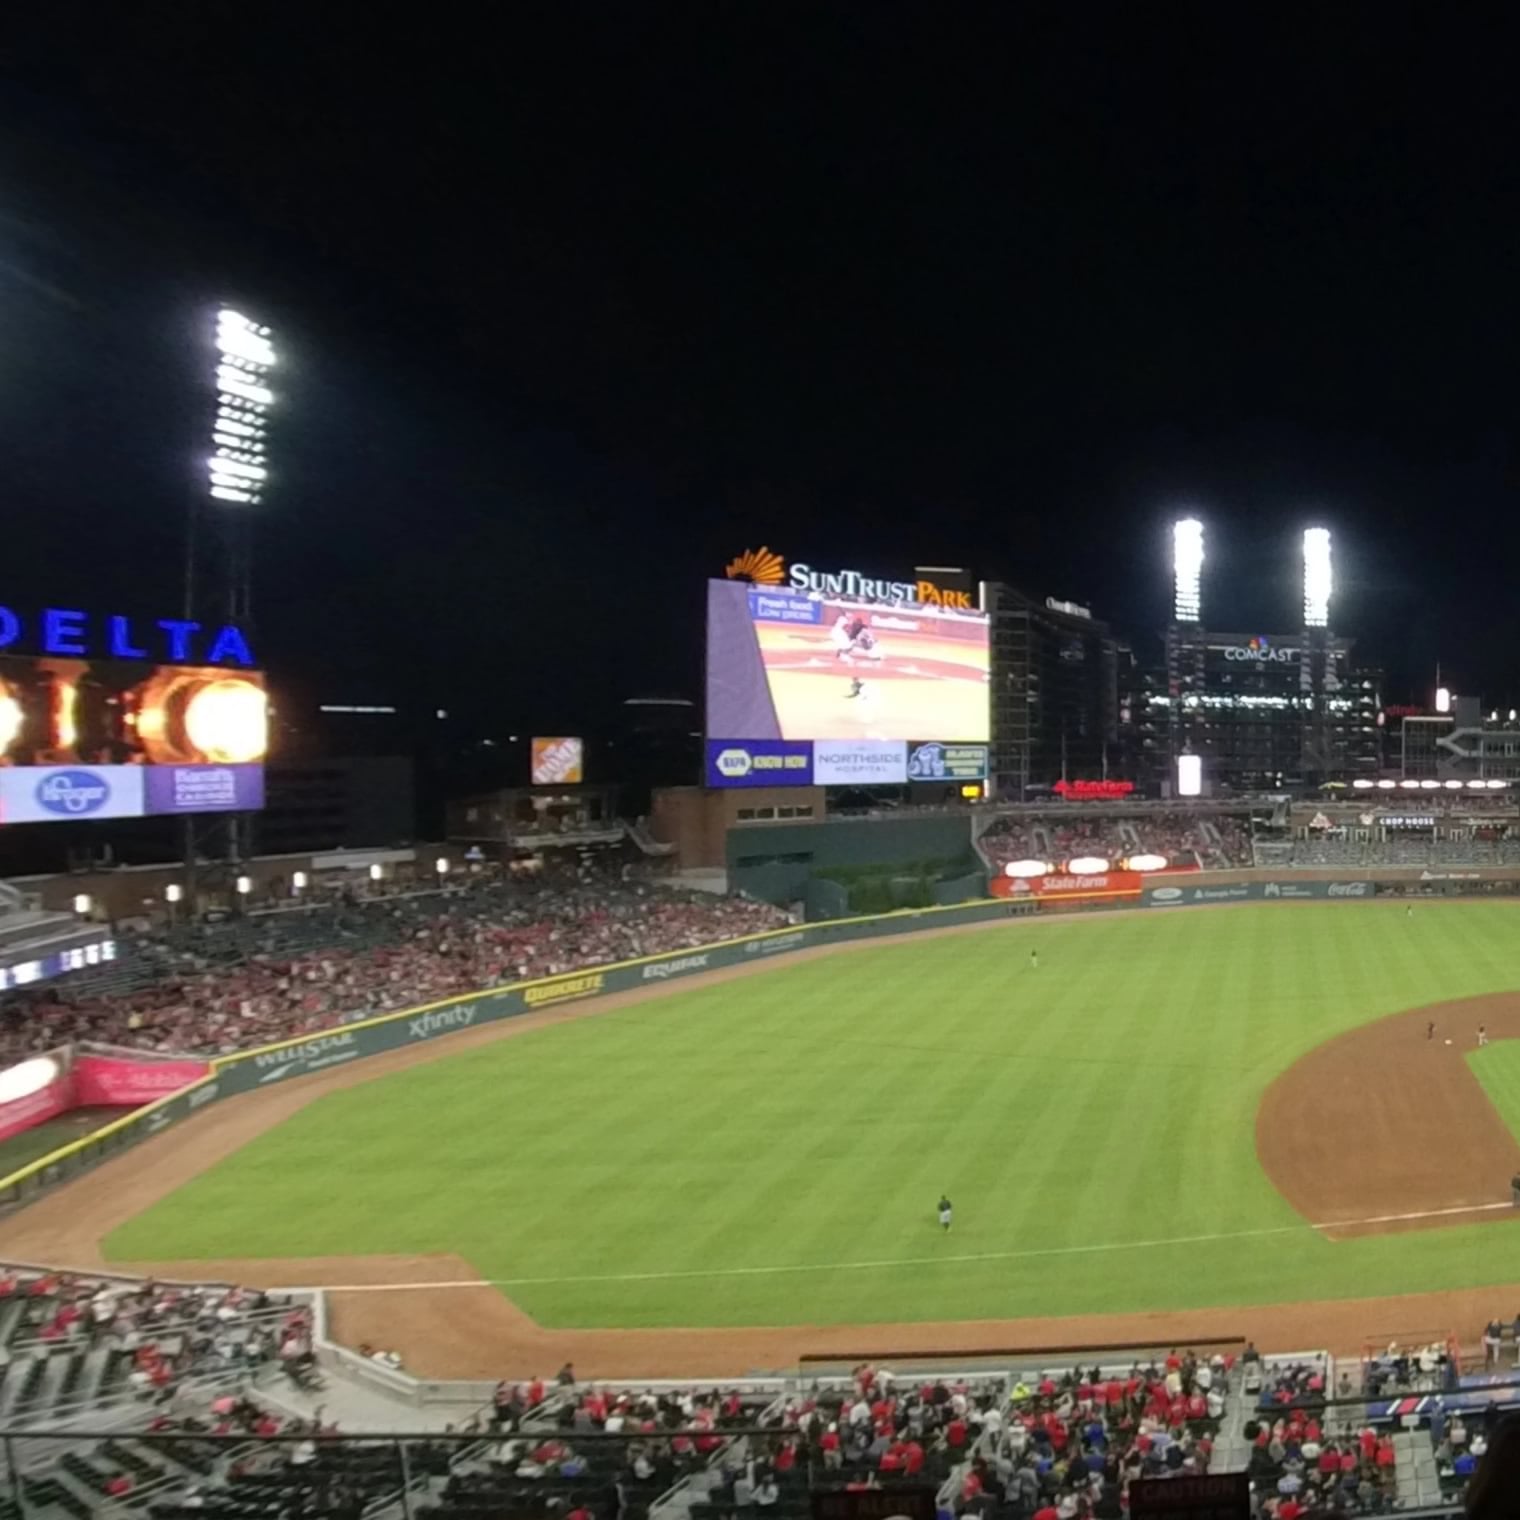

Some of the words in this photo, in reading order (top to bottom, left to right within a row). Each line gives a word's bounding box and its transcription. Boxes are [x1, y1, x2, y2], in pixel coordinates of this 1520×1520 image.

[1224, 648, 1294, 662] COMCAST
[818, 752, 901, 765] NORTHSIDE
[642, 954, 709, 978] EQUIFAX
[525, 974, 604, 1003] QUIKRETE
[409, 1003, 477, 1038] xfinity
